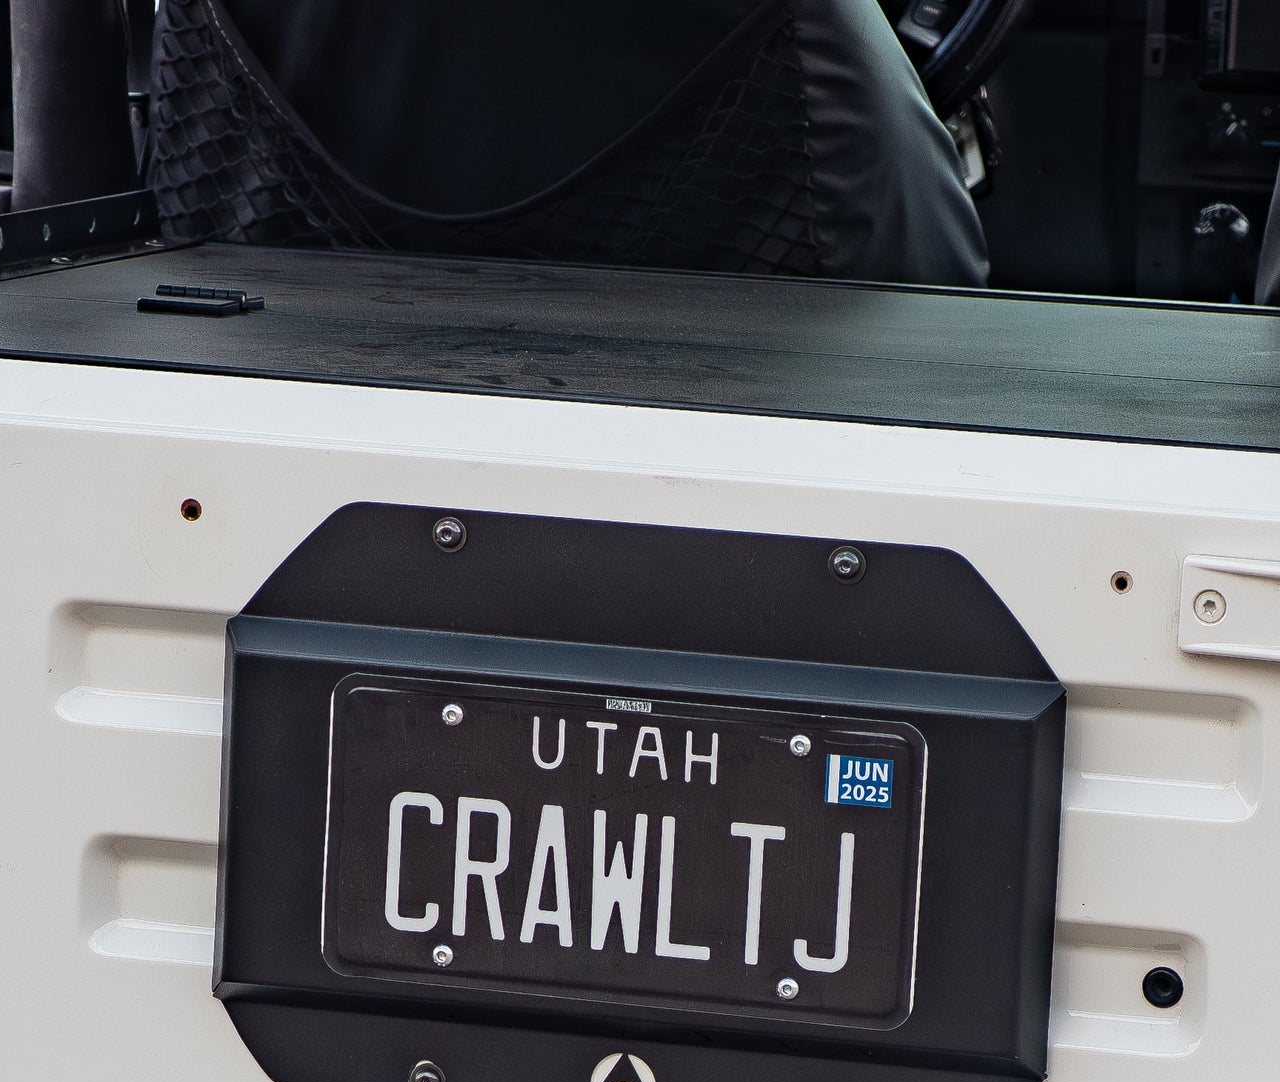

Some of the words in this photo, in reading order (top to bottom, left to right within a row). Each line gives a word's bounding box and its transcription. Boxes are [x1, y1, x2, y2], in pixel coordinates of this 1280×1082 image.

[531, 715, 719, 785] UTAH
[842, 759, 889, 783] JUN
[840, 783, 889, 803] 2025
